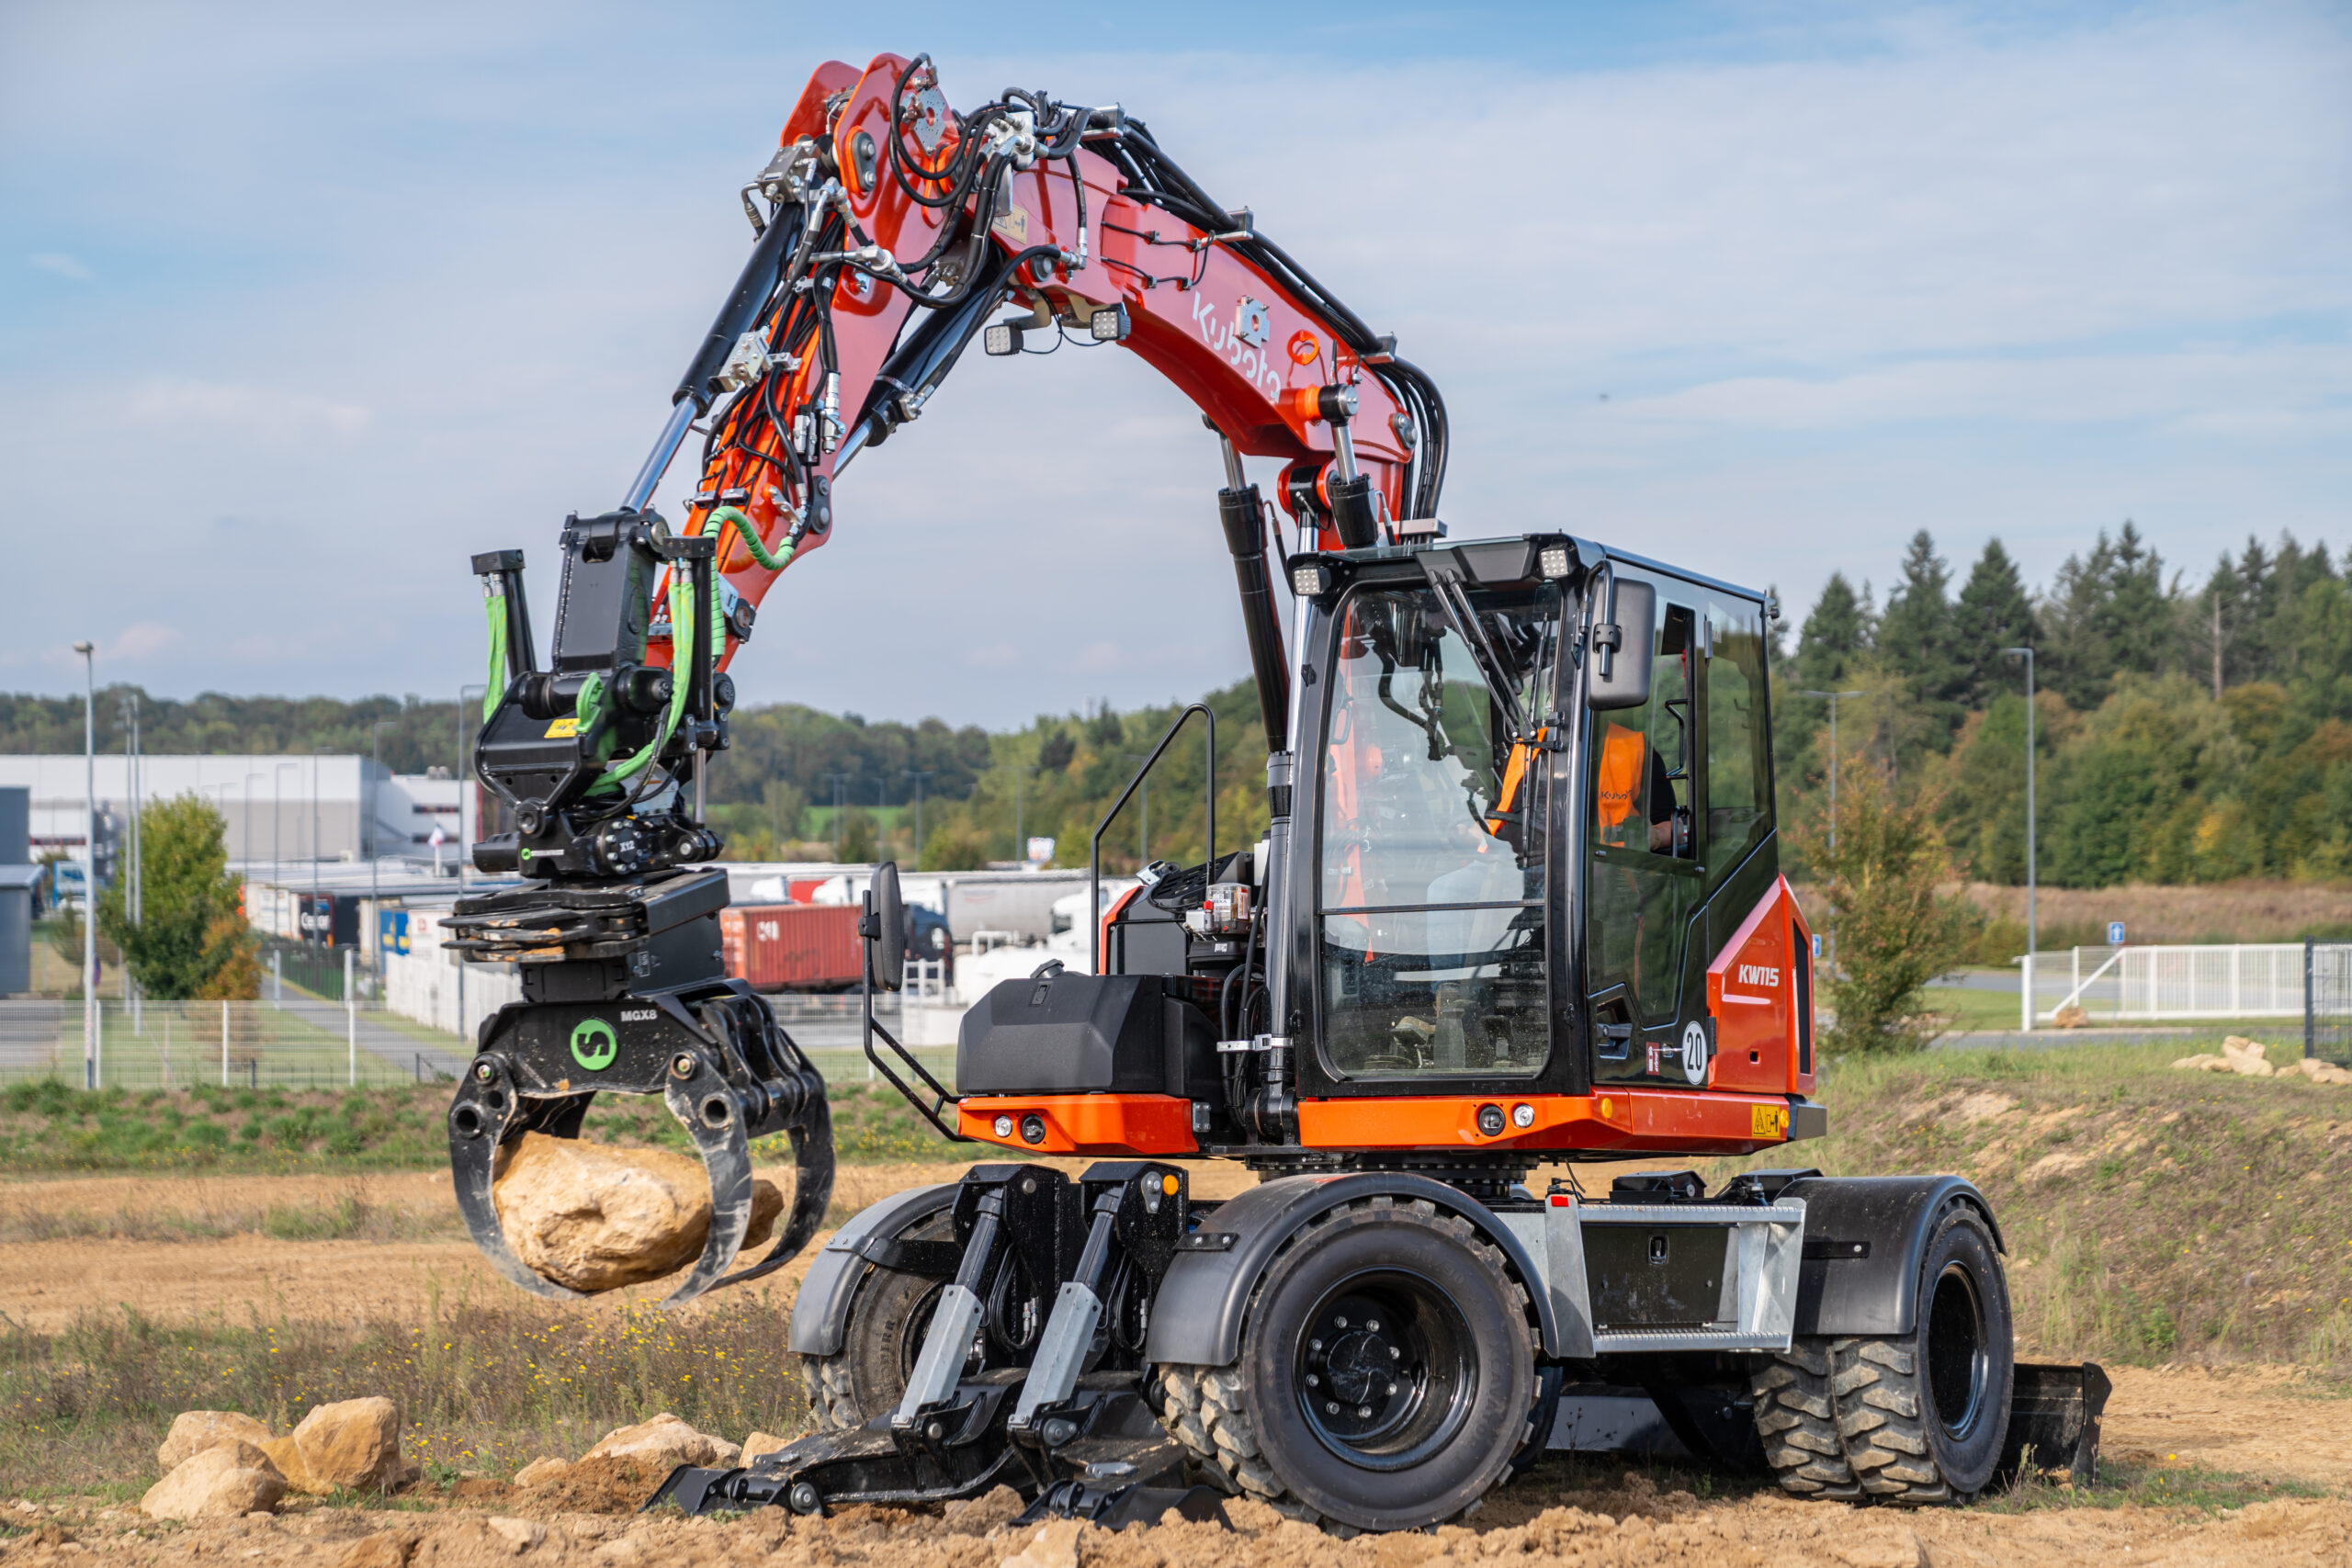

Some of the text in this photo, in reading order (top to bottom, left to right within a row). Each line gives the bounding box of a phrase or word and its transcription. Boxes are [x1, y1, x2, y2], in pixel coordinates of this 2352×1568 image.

[1193, 291, 1281, 404] Kubota
[619, 840, 636, 852] X12
[1738, 964, 1780, 987] KW115
[621, 1010, 658, 1021] MGX8
[1687, 1032, 1702, 1071] 20
